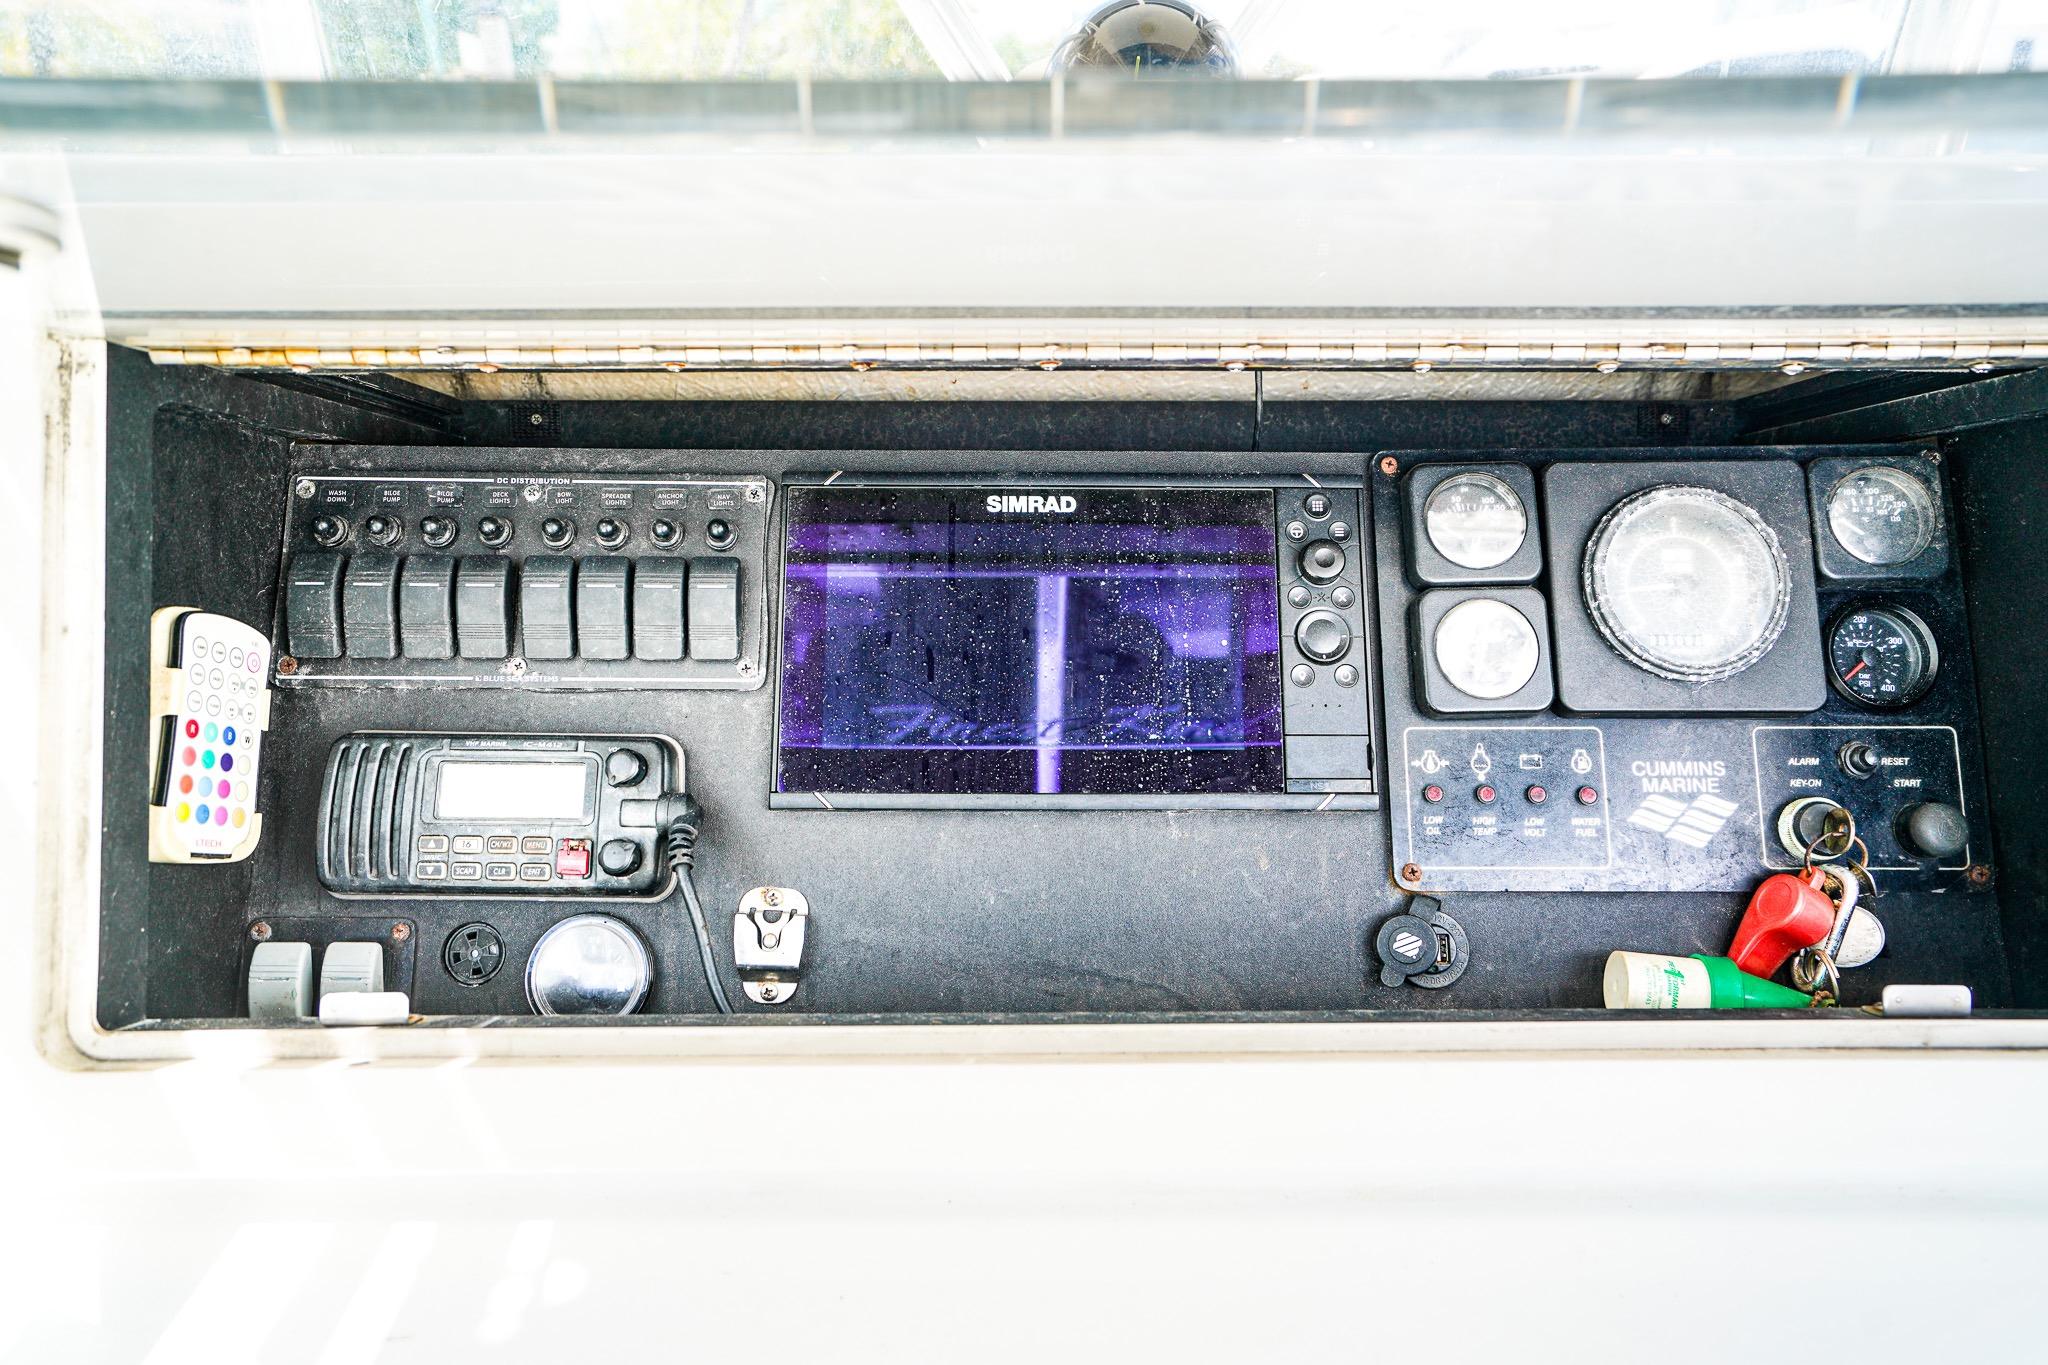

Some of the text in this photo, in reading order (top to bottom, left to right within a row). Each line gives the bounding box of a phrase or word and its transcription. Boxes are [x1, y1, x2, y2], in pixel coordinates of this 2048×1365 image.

[986, 495, 1077, 513] SIMRAD
[1852, 615, 1867, 623] 200
[1888, 637, 1903, 645] 300
[1880, 684, 1896, 692] 400
[1788, 757, 1820, 766] ALARM
[1880, 757, 1910, 766] RESET
[1632, 760, 1727, 778] CUMMINS
[1642, 776, 1721, 793] MARINE
[1789, 778, 1822, 788] KEY-ON
[1893, 779, 1922, 788] START
[1423, 816, 1444, 825] LOW
[1472, 816, 1497, 826] HIGH
[1524, 817, 1545, 826] LOW
[1571, 817, 1601, 827] WATER
[1425, 826, 1442, 836] OIL
[1473, 827, 1498, 836] TEMP
[1524, 828, 1547, 837] VOLT
[1575, 828, 1598, 837] FUEL
[526, 841, 547, 849] MENU
[454, 867, 474, 875] SCAN
[492, 867, 506, 875] CLR
[527, 867, 541, 875] ENT
